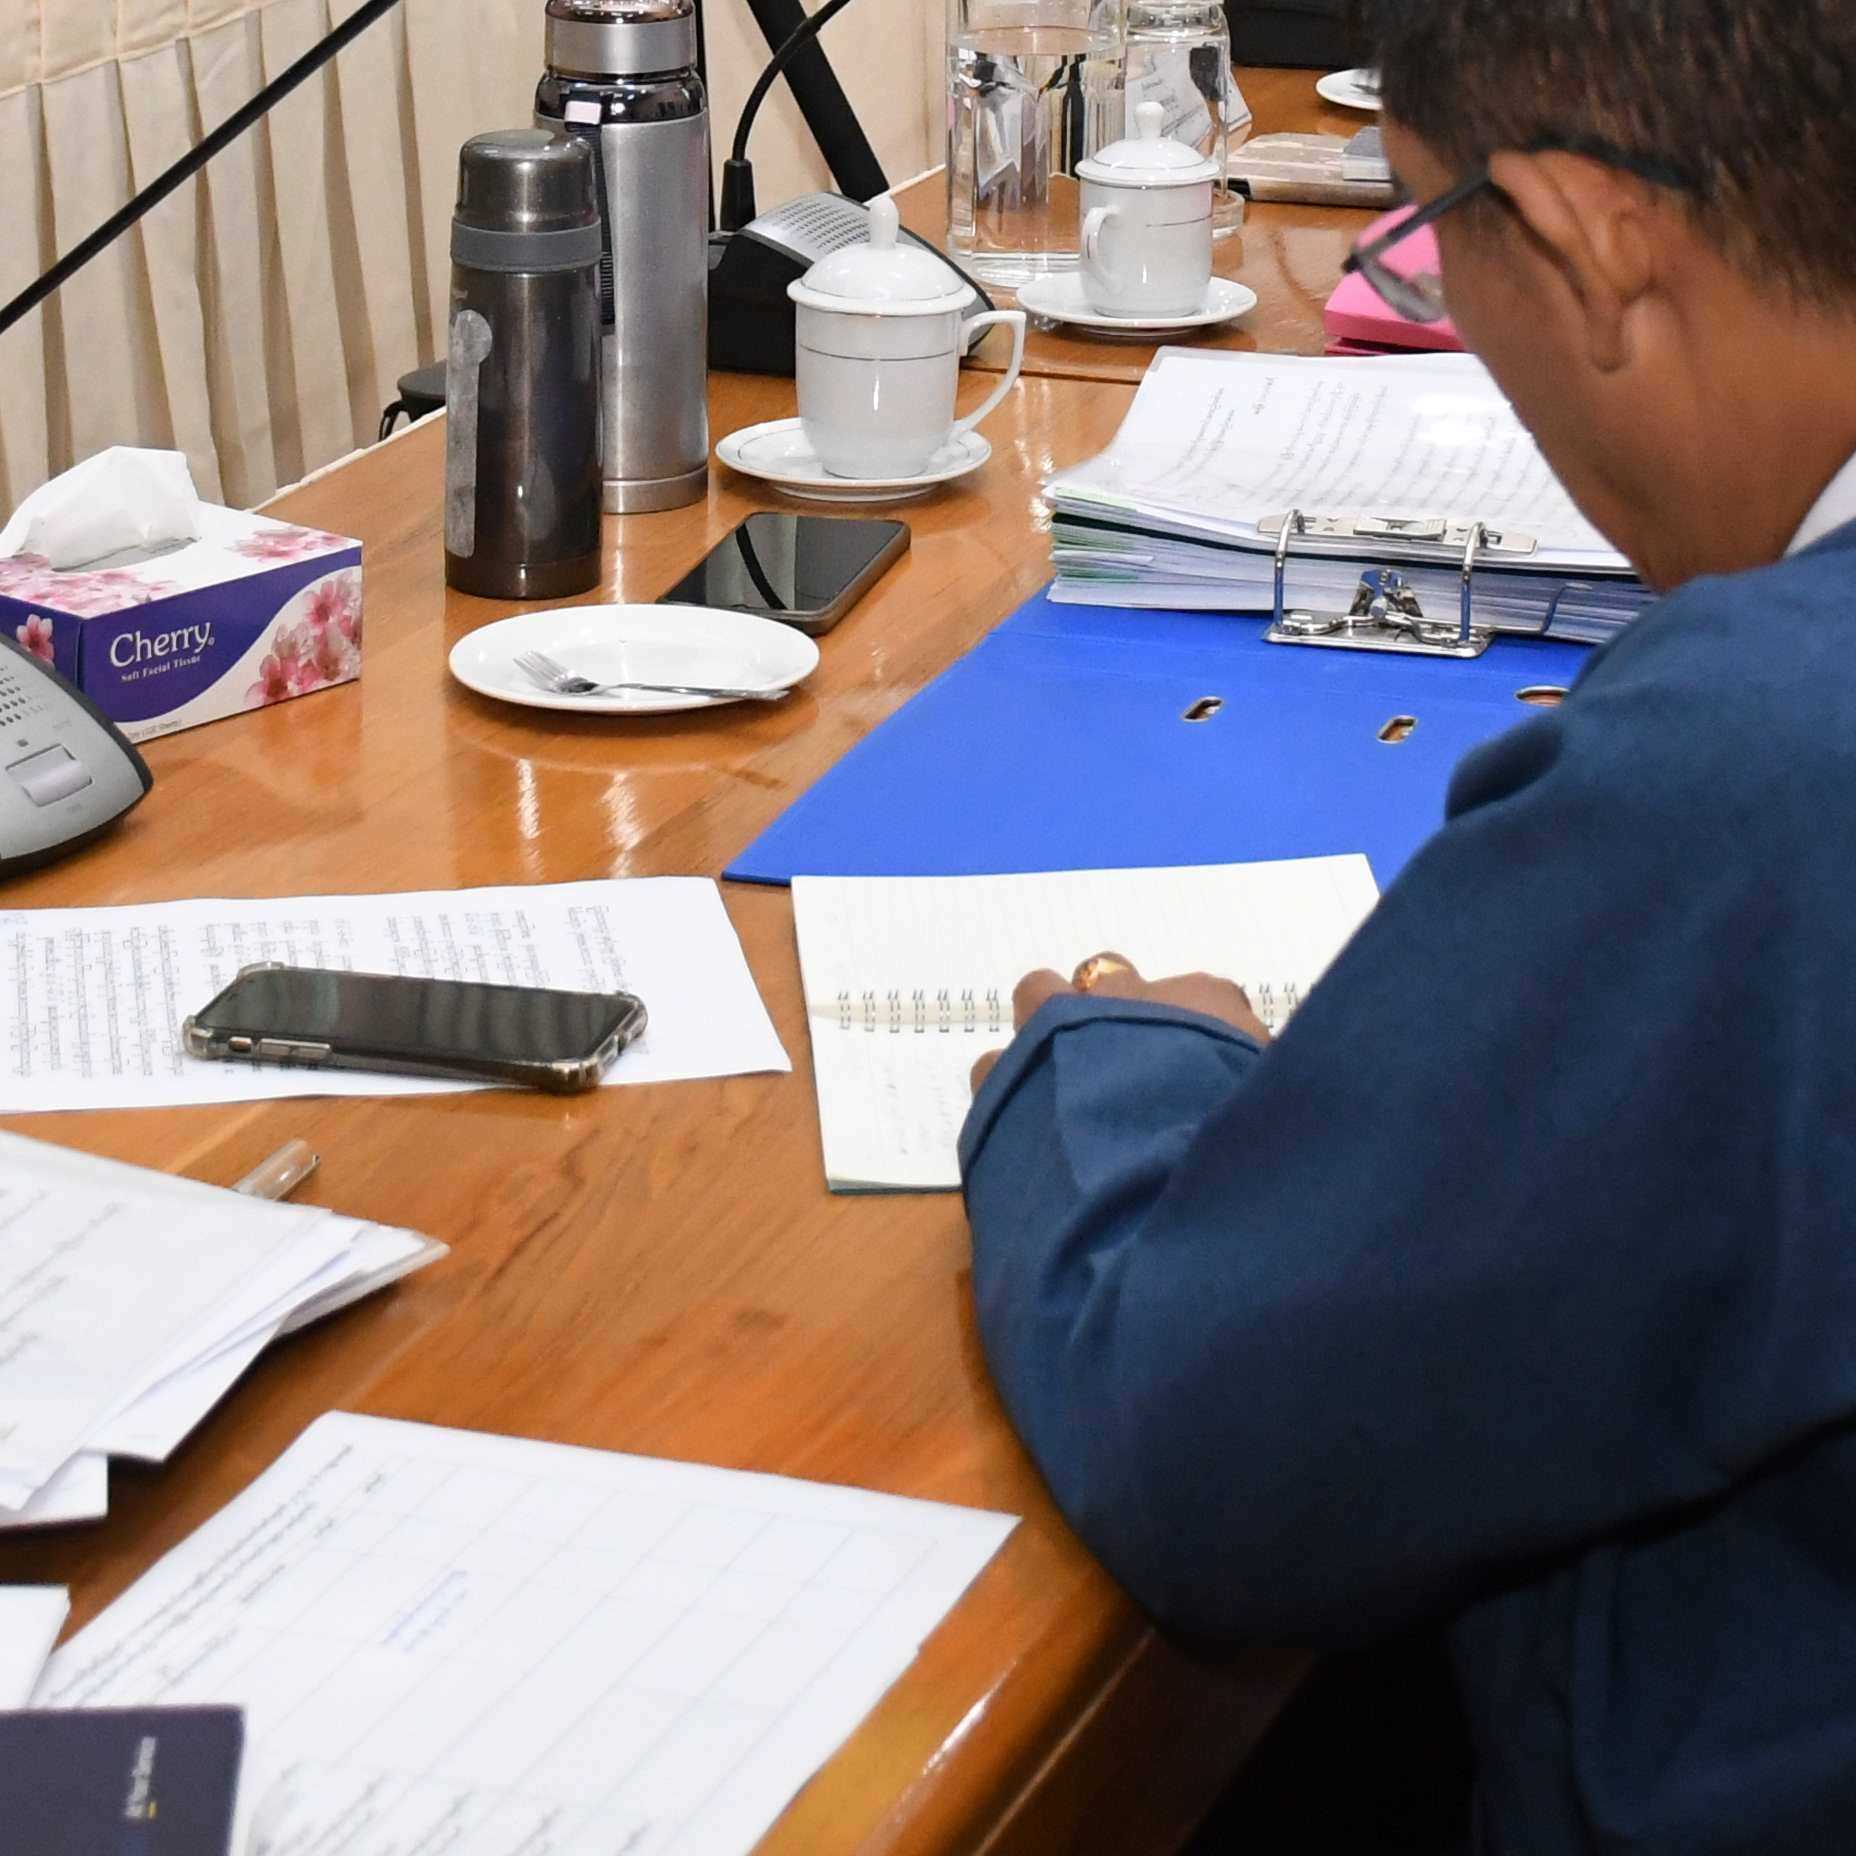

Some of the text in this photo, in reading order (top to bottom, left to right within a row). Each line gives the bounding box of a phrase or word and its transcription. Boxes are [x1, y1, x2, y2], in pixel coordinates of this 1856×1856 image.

[110, 622, 212, 668] Cherry
[142, 662, 171, 678] Facial
[173, 655, 201, 669] Tissue
